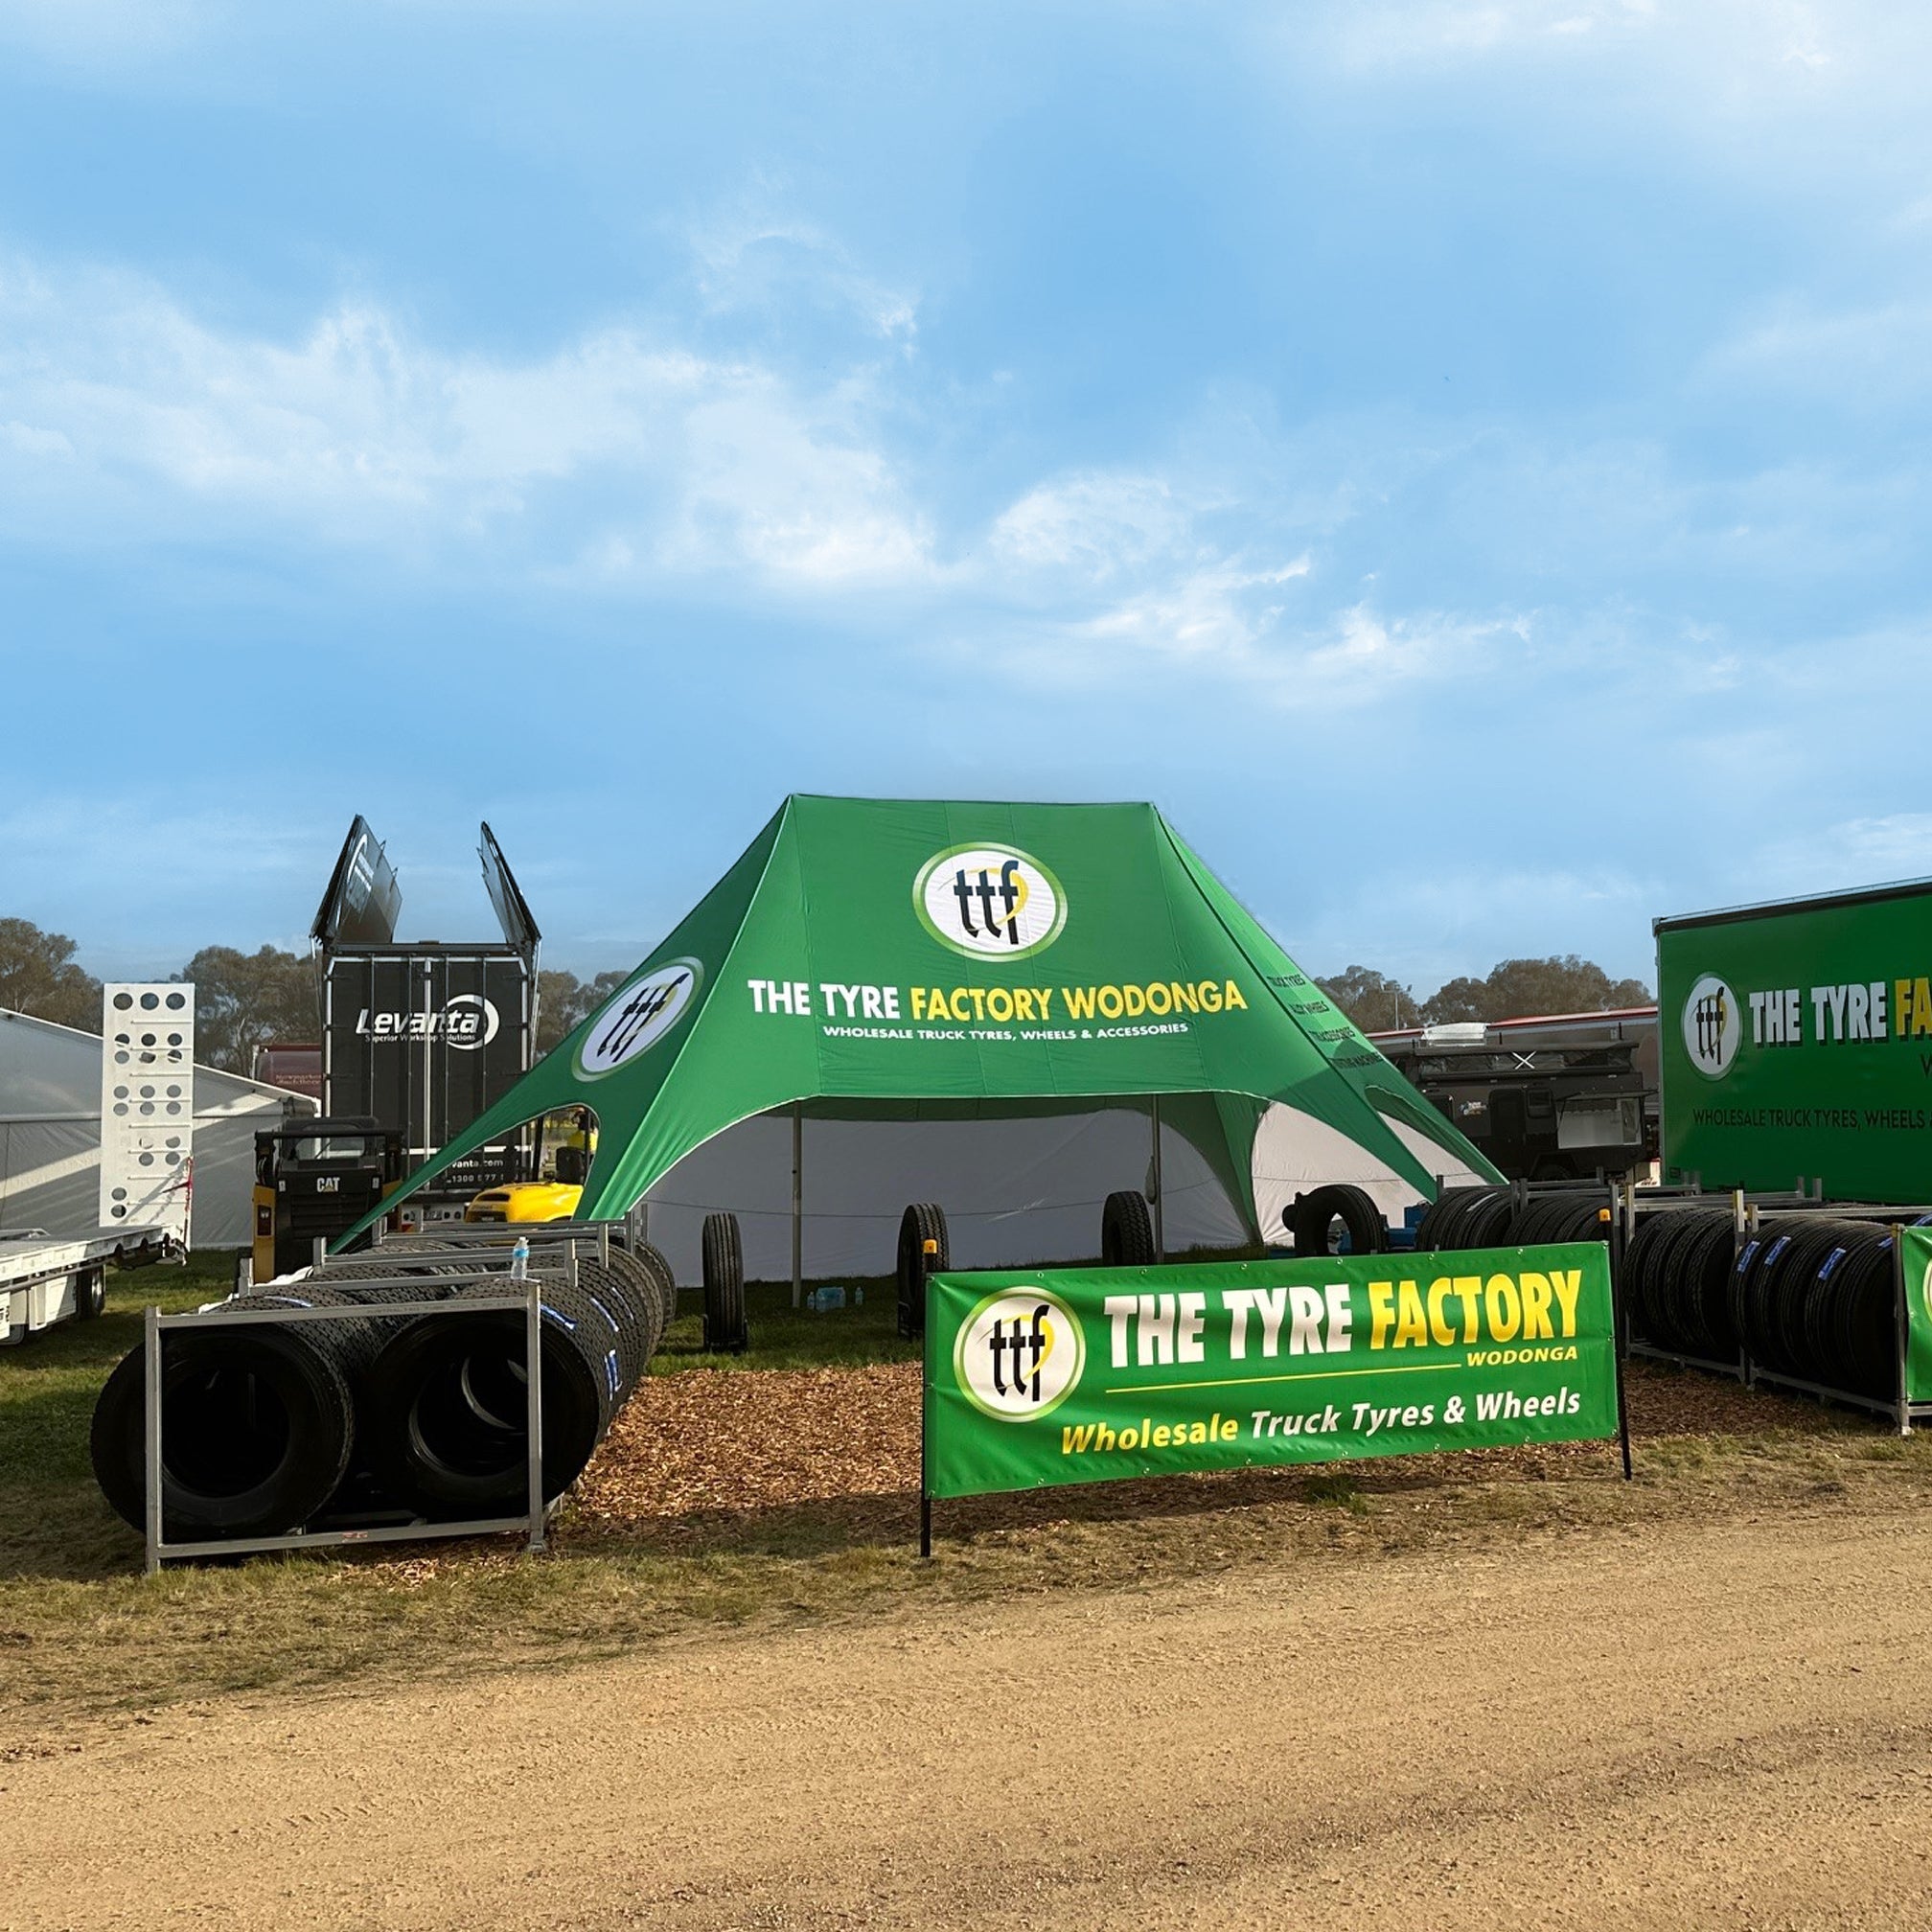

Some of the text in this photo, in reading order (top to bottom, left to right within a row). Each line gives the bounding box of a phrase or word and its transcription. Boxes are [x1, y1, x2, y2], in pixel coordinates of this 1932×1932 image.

[954, 860, 1020, 945] ttf
[748, 979, 1249, 1022] THE TYRE FACTORY WODONGA
[1749, 988, 1802, 1045] THE
[1810, 981, 1887, 1041] TYRE
[356, 1008, 479, 1034] Levanta
[823, 1023, 1188, 1042] WHOLESALE TRUCK TYRES, WHEELS & ACCESSORIES
[365, 1034, 398, 1044] Sperior
[400, 1034, 438, 1043] Wrksop
[1692, 1109, 1926, 1131] WHOLESALE TRUCK TYRES, WHEELS
[316, 1177, 340, 1193] CAT
[1104, 1270, 1581, 1368] THE TYRE FACTORY
[990, 1304, 1050, 1402] ttf
[1466, 1346, 1578, 1367] WODONGA
[1062, 1386, 1581, 1455] Wholesale Truck Tyres & Wheels
